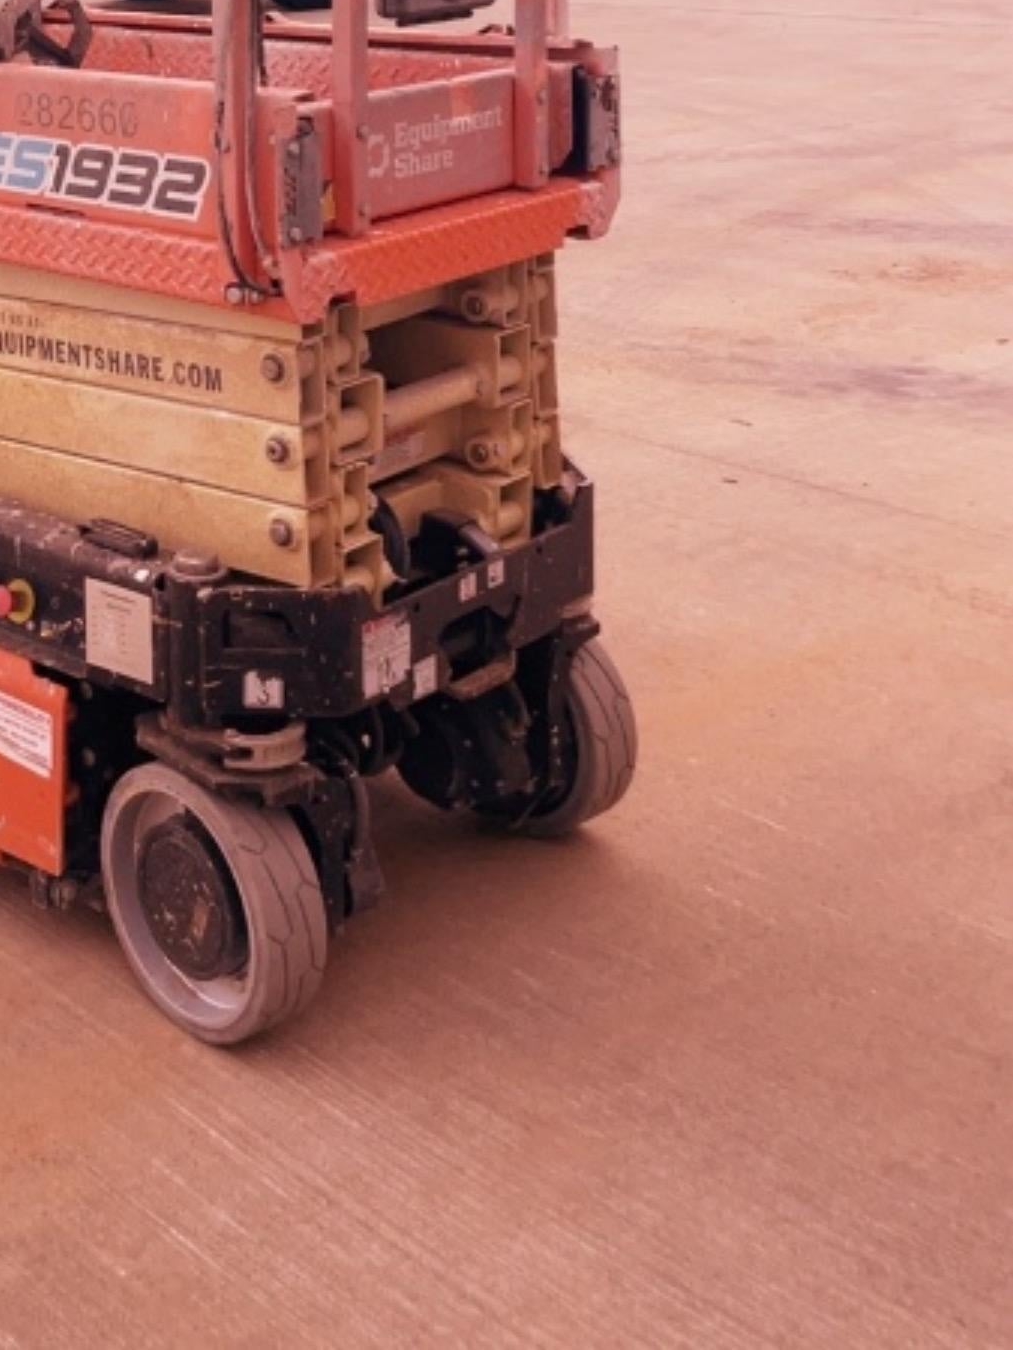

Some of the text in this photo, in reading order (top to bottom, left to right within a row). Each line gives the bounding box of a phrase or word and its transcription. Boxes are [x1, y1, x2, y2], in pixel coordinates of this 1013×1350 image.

[15, 92, 139, 139] 282660
[394, 106, 503, 148] Equipment
[394, 149, 454, 179] Share
